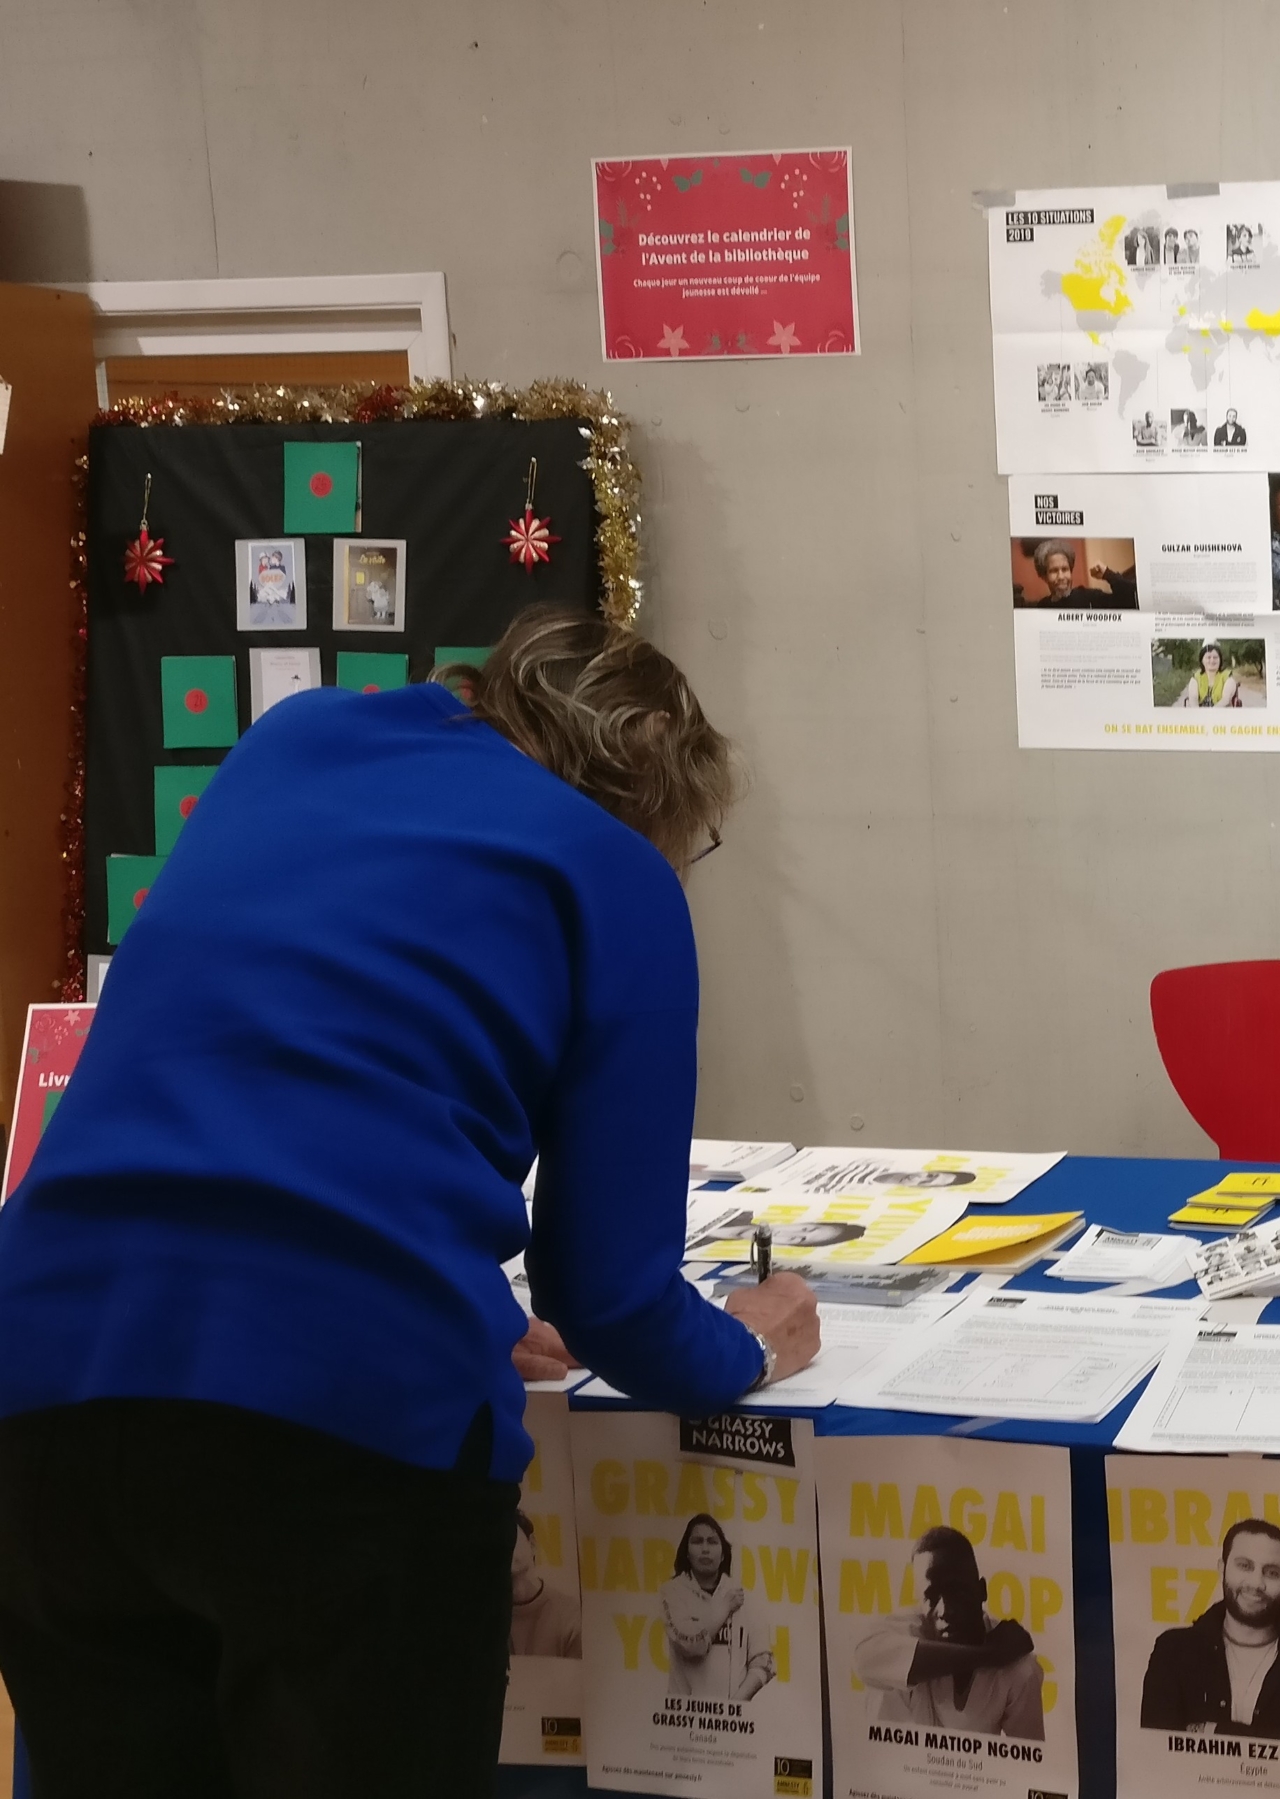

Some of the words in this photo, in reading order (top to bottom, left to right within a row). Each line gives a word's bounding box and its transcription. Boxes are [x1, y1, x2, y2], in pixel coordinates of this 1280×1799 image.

[1008, 212, 1025, 225] LES
[1027, 211, 1038, 224] 10
[1040, 209, 1092, 224] SITUATIONS
[638, 232, 705, 246] Découvrez
[707, 230, 720, 243] le
[723, 227, 792, 243] calendrier
[794, 226, 811, 240] de
[641, 251, 687, 266] l'Avent
[690, 250, 706, 264] de
[708, 249, 721, 263] la
[724, 247, 809, 263] bibliothèque
[633, 278, 661, 288] Chaque
[1036, 496, 1055, 508] NOS
[1037, 511, 1081, 524] VICTOIRES
[1161, 543, 1191, 552] GULZAR
[1057, 613, 1084, 622] ALBERT
[1086, 613, 1123, 622] WOODFOX
[1104, 723, 1118, 733] ON
[1121, 724, 1132, 734] SE
[1135, 723, 1153, 734] BAT
[1212, 724, 1227, 735] ON
[1230, 724, 1263, 735] GAGNE
[707, 1414, 774, 1439] GRASSY
[692, 1429, 785, 1458] NARROWS
[591, 1459, 800, 1524] GRASSY
[849, 1481, 1047, 1553] MAGAI
[664, 1697, 682, 1711] LES
[685, 1699, 724, 1716] JEUNES
[728, 1704, 742, 1717] DE
[652, 1712, 695, 1728] GRASSY
[698, 1717, 755, 1734] NARROWS
[689, 1730, 717, 1744] Canada
[868, 1725, 919, 1747] MAGAI
[924, 1732, 983, 1755] MATIOP
[987, 1740, 1043, 1763] NGONG
[1168, 1735, 1242, 1758] IBRAHIM
[1249, 1742, 1279, 1762] EZZ
[777, 1758, 790, 1776] 10
[926, 1752, 955, 1767] Soudan
[956, 1756, 967, 1768] du
[968, 1758, 983, 1771] Sud
[1240, 1762, 1268, 1776] Égypte
